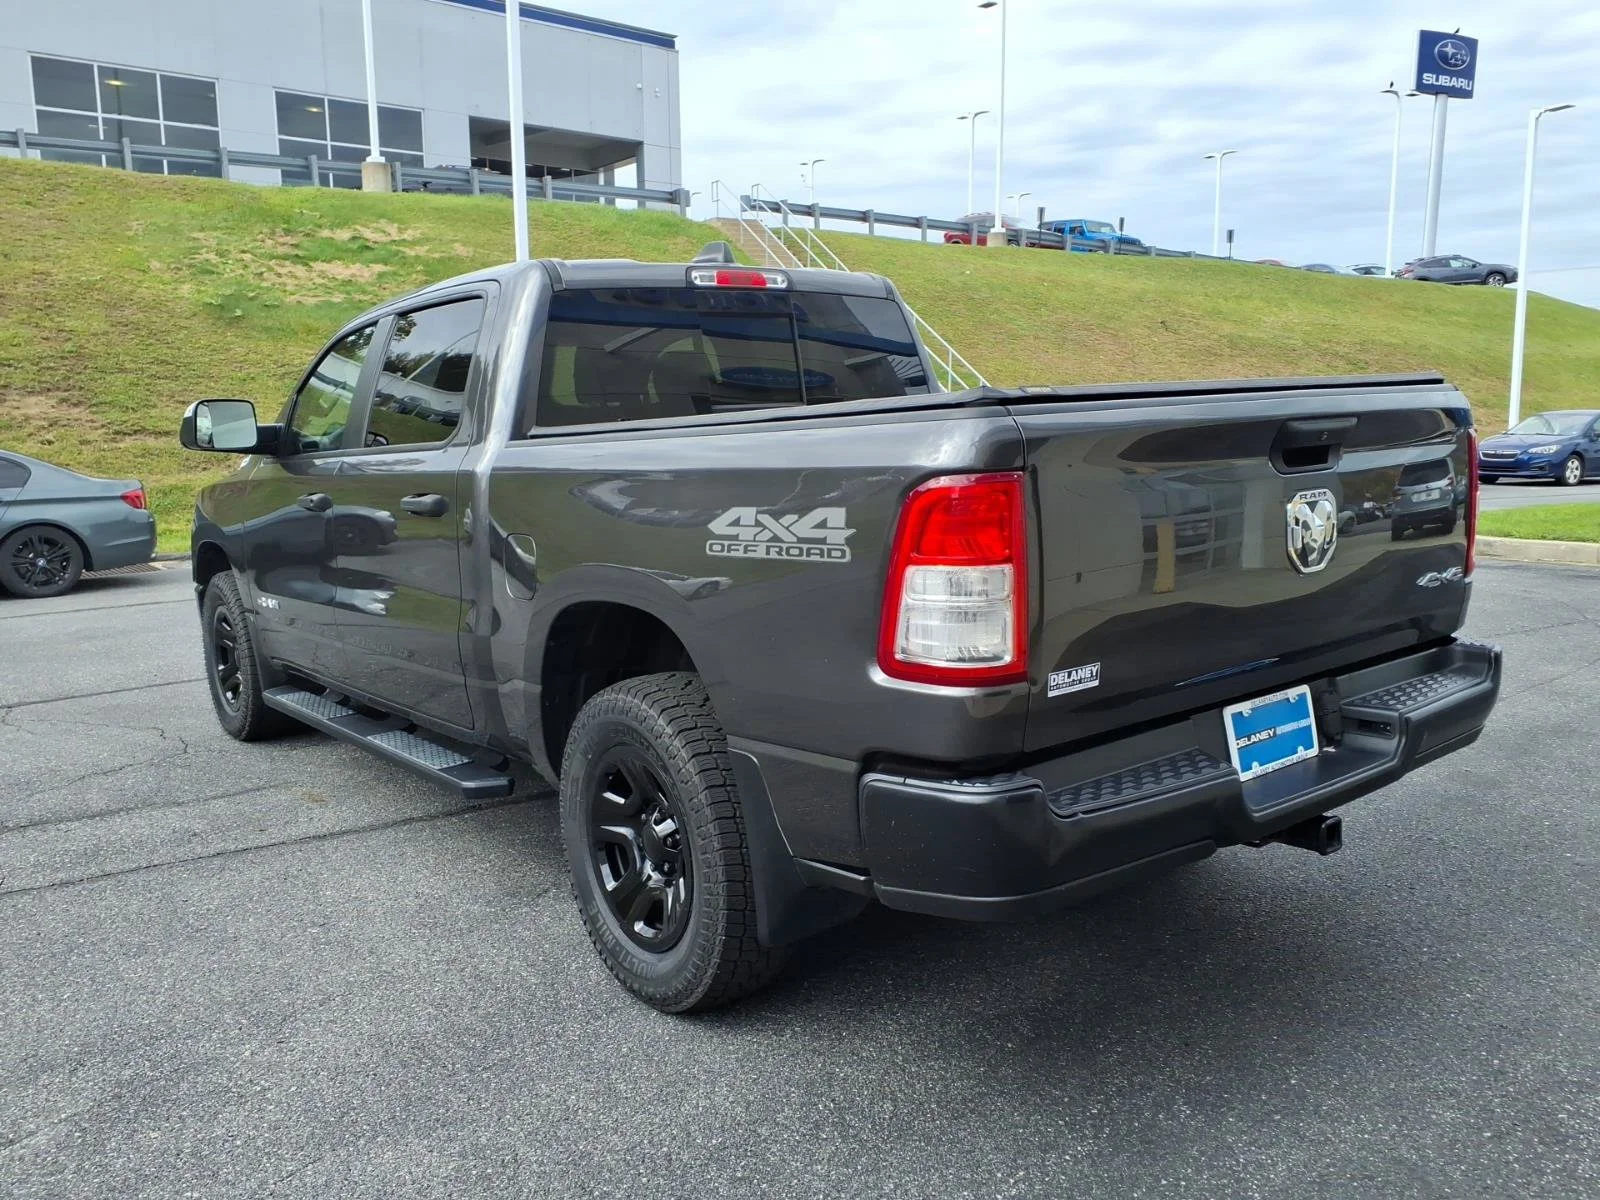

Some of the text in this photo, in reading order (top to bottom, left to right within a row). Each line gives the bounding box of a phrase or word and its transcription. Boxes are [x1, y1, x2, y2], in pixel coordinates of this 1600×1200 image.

[1422, 73, 1472, 90] SUBARU
[1299, 491, 1328, 500] RAM
[708, 542, 847, 560] OFF ROAD
[1050, 665, 1098, 686] DELANEY
[1235, 728, 1275, 750] DELANEY
